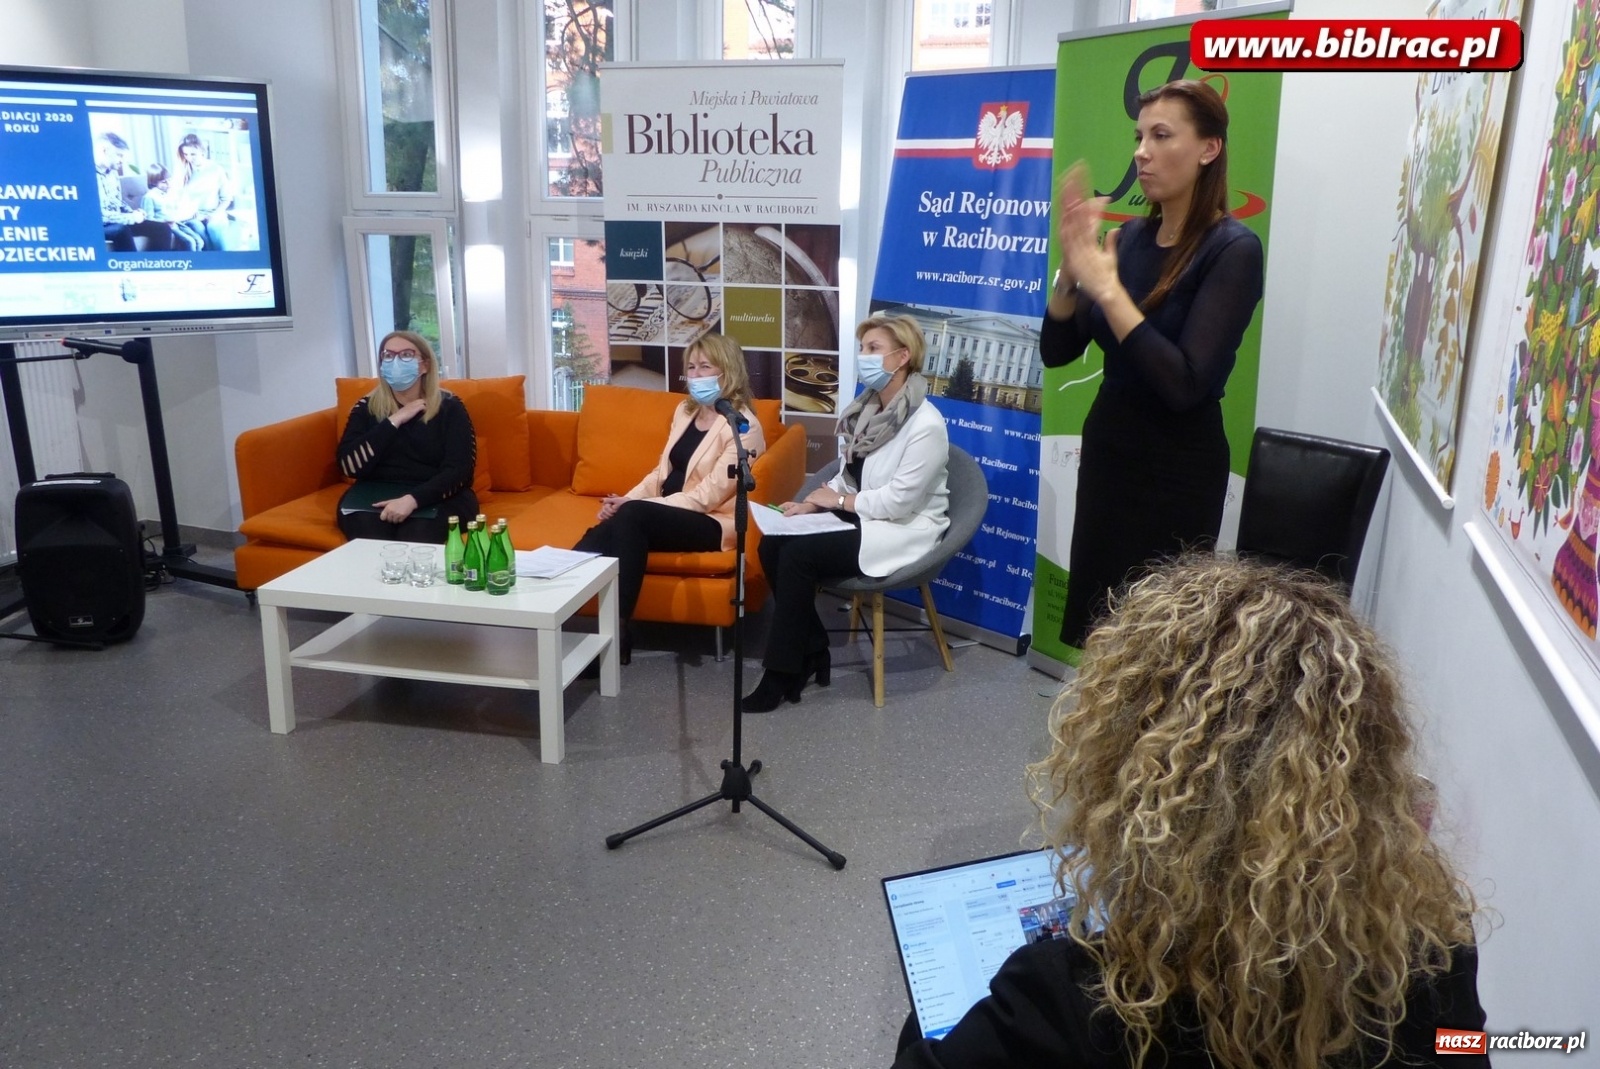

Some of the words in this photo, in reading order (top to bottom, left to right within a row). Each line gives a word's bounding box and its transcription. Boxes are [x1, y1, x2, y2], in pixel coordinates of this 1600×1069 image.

[689, 90, 738, 110] Miejska
[741, 91, 747, 106] i
[748, 90, 819, 106] Powiatowa
[0, 111, 41, 123] DIACJI
[44, 112, 74, 122] 2020
[4, 123, 40, 133] ROKU
[624, 112, 818, 155] Biblioteka
[698, 159, 802, 186] Publiczna
[627, 203, 643, 212] IM.
[647, 203, 699, 213] RYSZARDA
[701, 204, 740, 214] KINCLA
[743, 205, 752, 214] W
[756, 205, 818, 215] RACIBORZU
[918, 191, 955, 218] Sąd
[958, 191, 1052, 219] Rejonow
[922, 231, 938, 247] w
[942, 226, 1048, 254] Raciborzu
[619, 247, 648, 260] książki
[108, 258, 193, 271] Organizatorzy:
[916, 271, 1042, 293] www.raciborz.sr.gov.pl
[730, 312, 775, 323] multimedia
[958, 418, 993, 433] Raciborzu
[981, 456, 1018, 471] Raciborzu
[1012, 497, 1038, 511] Racibo
[996, 527, 1031, 545] Rejonowy
